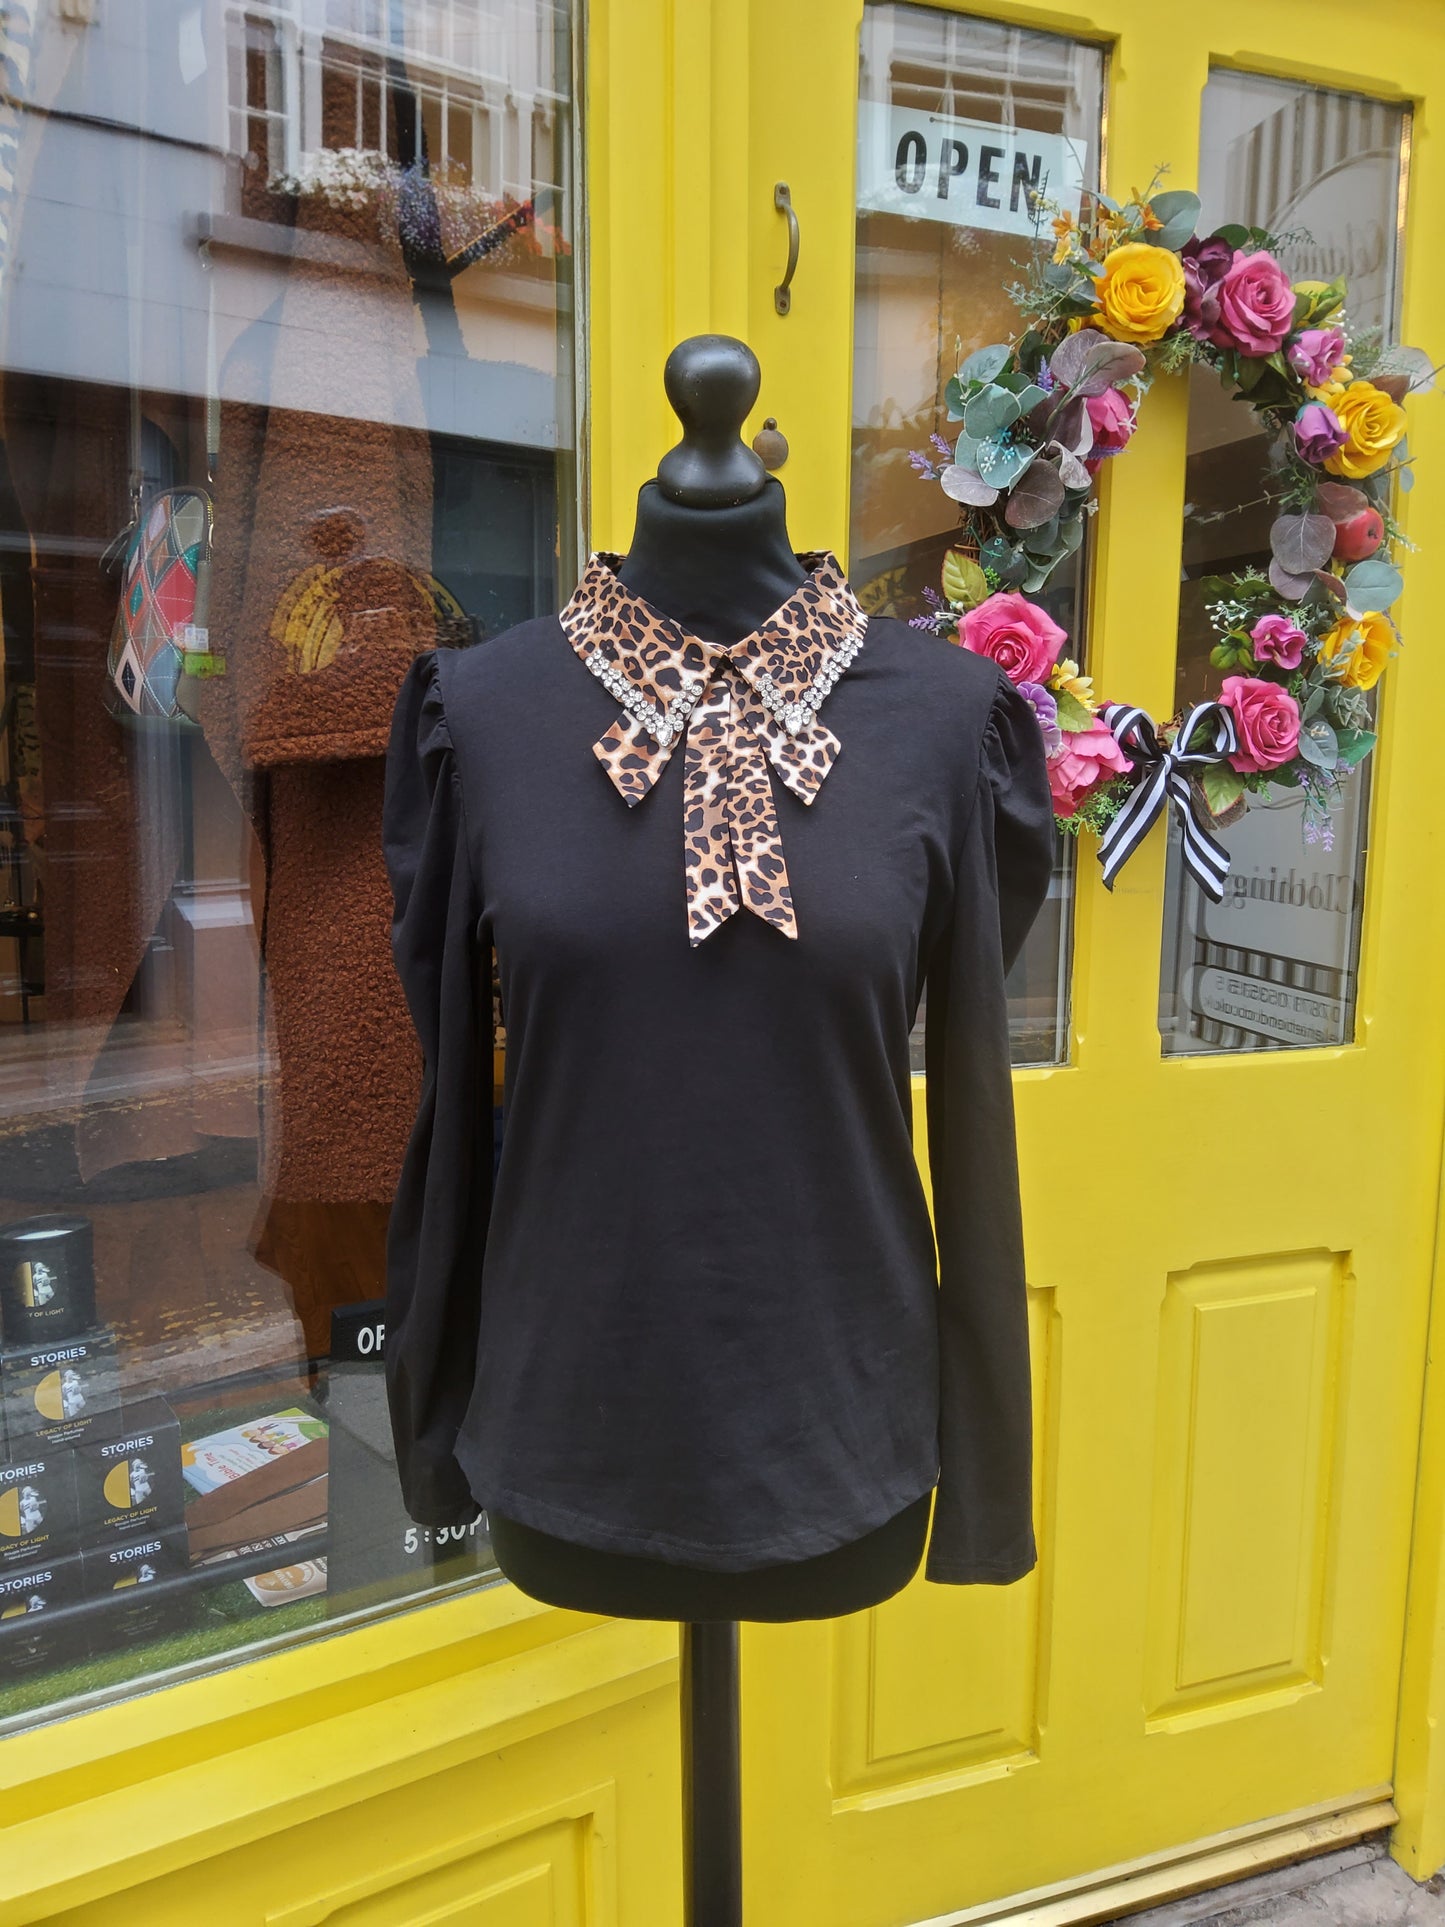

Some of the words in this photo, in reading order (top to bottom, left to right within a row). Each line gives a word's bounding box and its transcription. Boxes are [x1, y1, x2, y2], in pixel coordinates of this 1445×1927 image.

[895, 130, 1043, 222] OPEN
[30, 1346, 87, 1367] STORIES
[35, 1426, 62, 1438] LEGACY
[74, 1417, 93, 1428] LIGHT
[101, 1435, 154, 1457] STORIES
[0, 1462, 45, 1482] TORIES
[103, 1514, 129, 1526] LEGACY
[129, 1511, 139, 1519] OF
[140, 1505, 159, 1516] LIGHT
[30, 1534, 50, 1544] LIGHT
[109, 1540, 162, 1564] STORIES
